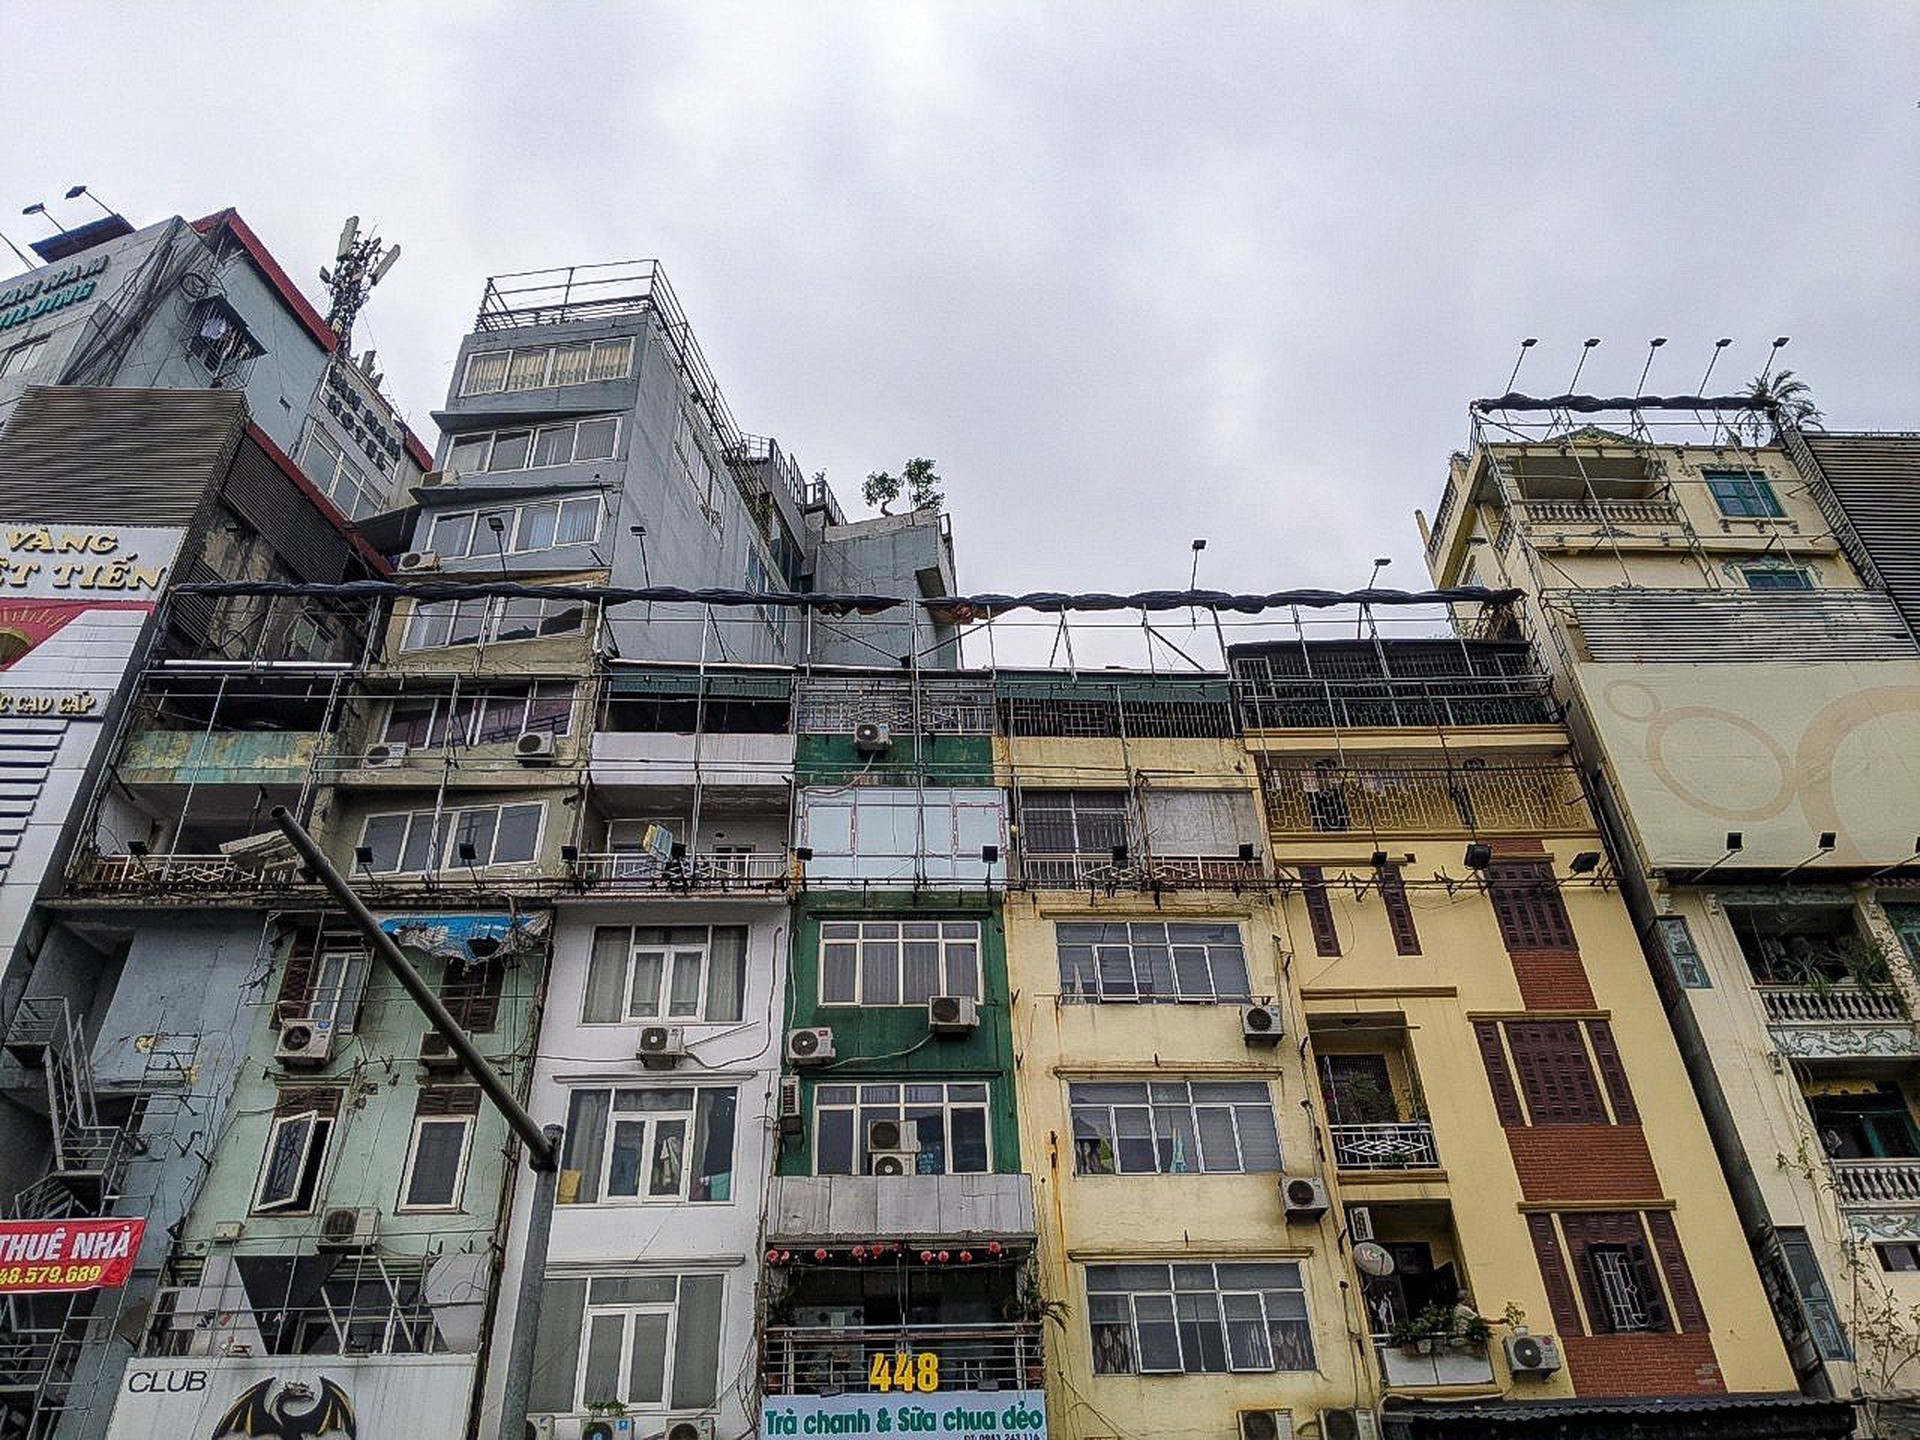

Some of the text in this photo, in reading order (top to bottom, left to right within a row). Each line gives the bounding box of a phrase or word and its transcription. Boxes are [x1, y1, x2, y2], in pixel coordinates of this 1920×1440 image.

[328, 393, 386, 471] HOTEL
[6, 526, 120, 555] VÀNG
[53, 553, 168, 590] TIẾN
[57, 690, 97, 714] CẤP
[0, 1225, 131, 1262] THUÊ NHÀ
[128, 1370, 208, 1394] CLUB
[869, 1352, 939, 1393] 448
[765, 1400, 1043, 1435] Trà chanh & Sữa chua dẻo
